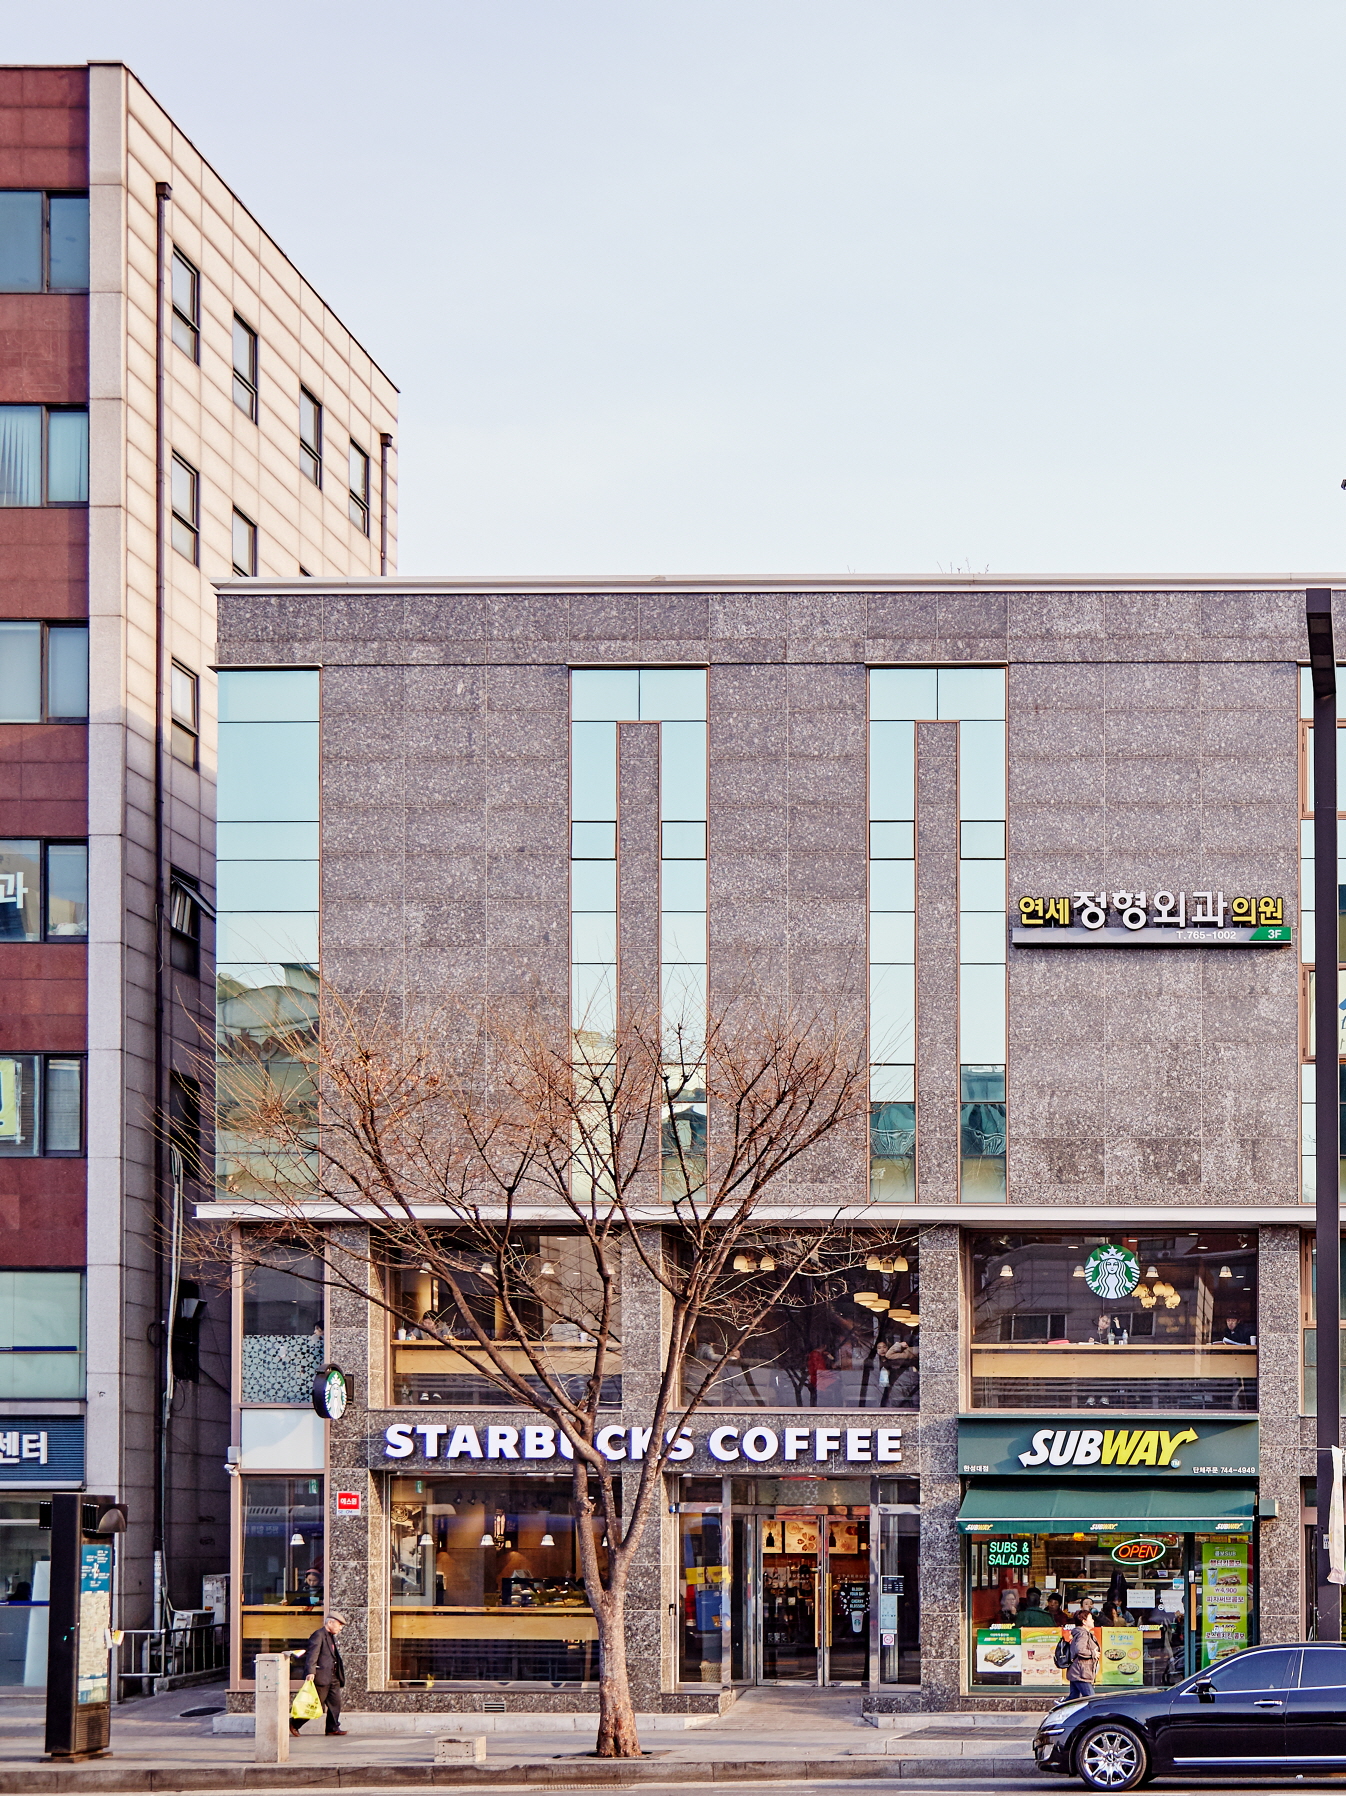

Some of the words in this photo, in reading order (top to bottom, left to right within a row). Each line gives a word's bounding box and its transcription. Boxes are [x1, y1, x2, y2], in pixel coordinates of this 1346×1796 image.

[1176, 930, 1237, 940] T.765-1002
[1268, 929, 1282, 939] 3F
[0, 1431, 48, 1464] 센터
[709, 1426, 902, 1462] COFFEE
[1018, 1427, 1199, 1468] SUBWAY
[963, 1464, 989, 1472] 한성대점
[1193, 1466, 1218, 1474] 단체주문
[965, 1523, 993, 1531] SUBWAY
[1090, 1523, 1118, 1531] SUBWAY
[1215, 1523, 1243, 1531] SUBWAY
[989, 1541, 1017, 1552] SUBS
[1022, 1541, 1029, 1552] &
[1118, 1544, 1159, 1558] OPEN
[988, 1554, 1030, 1566] SALADS
